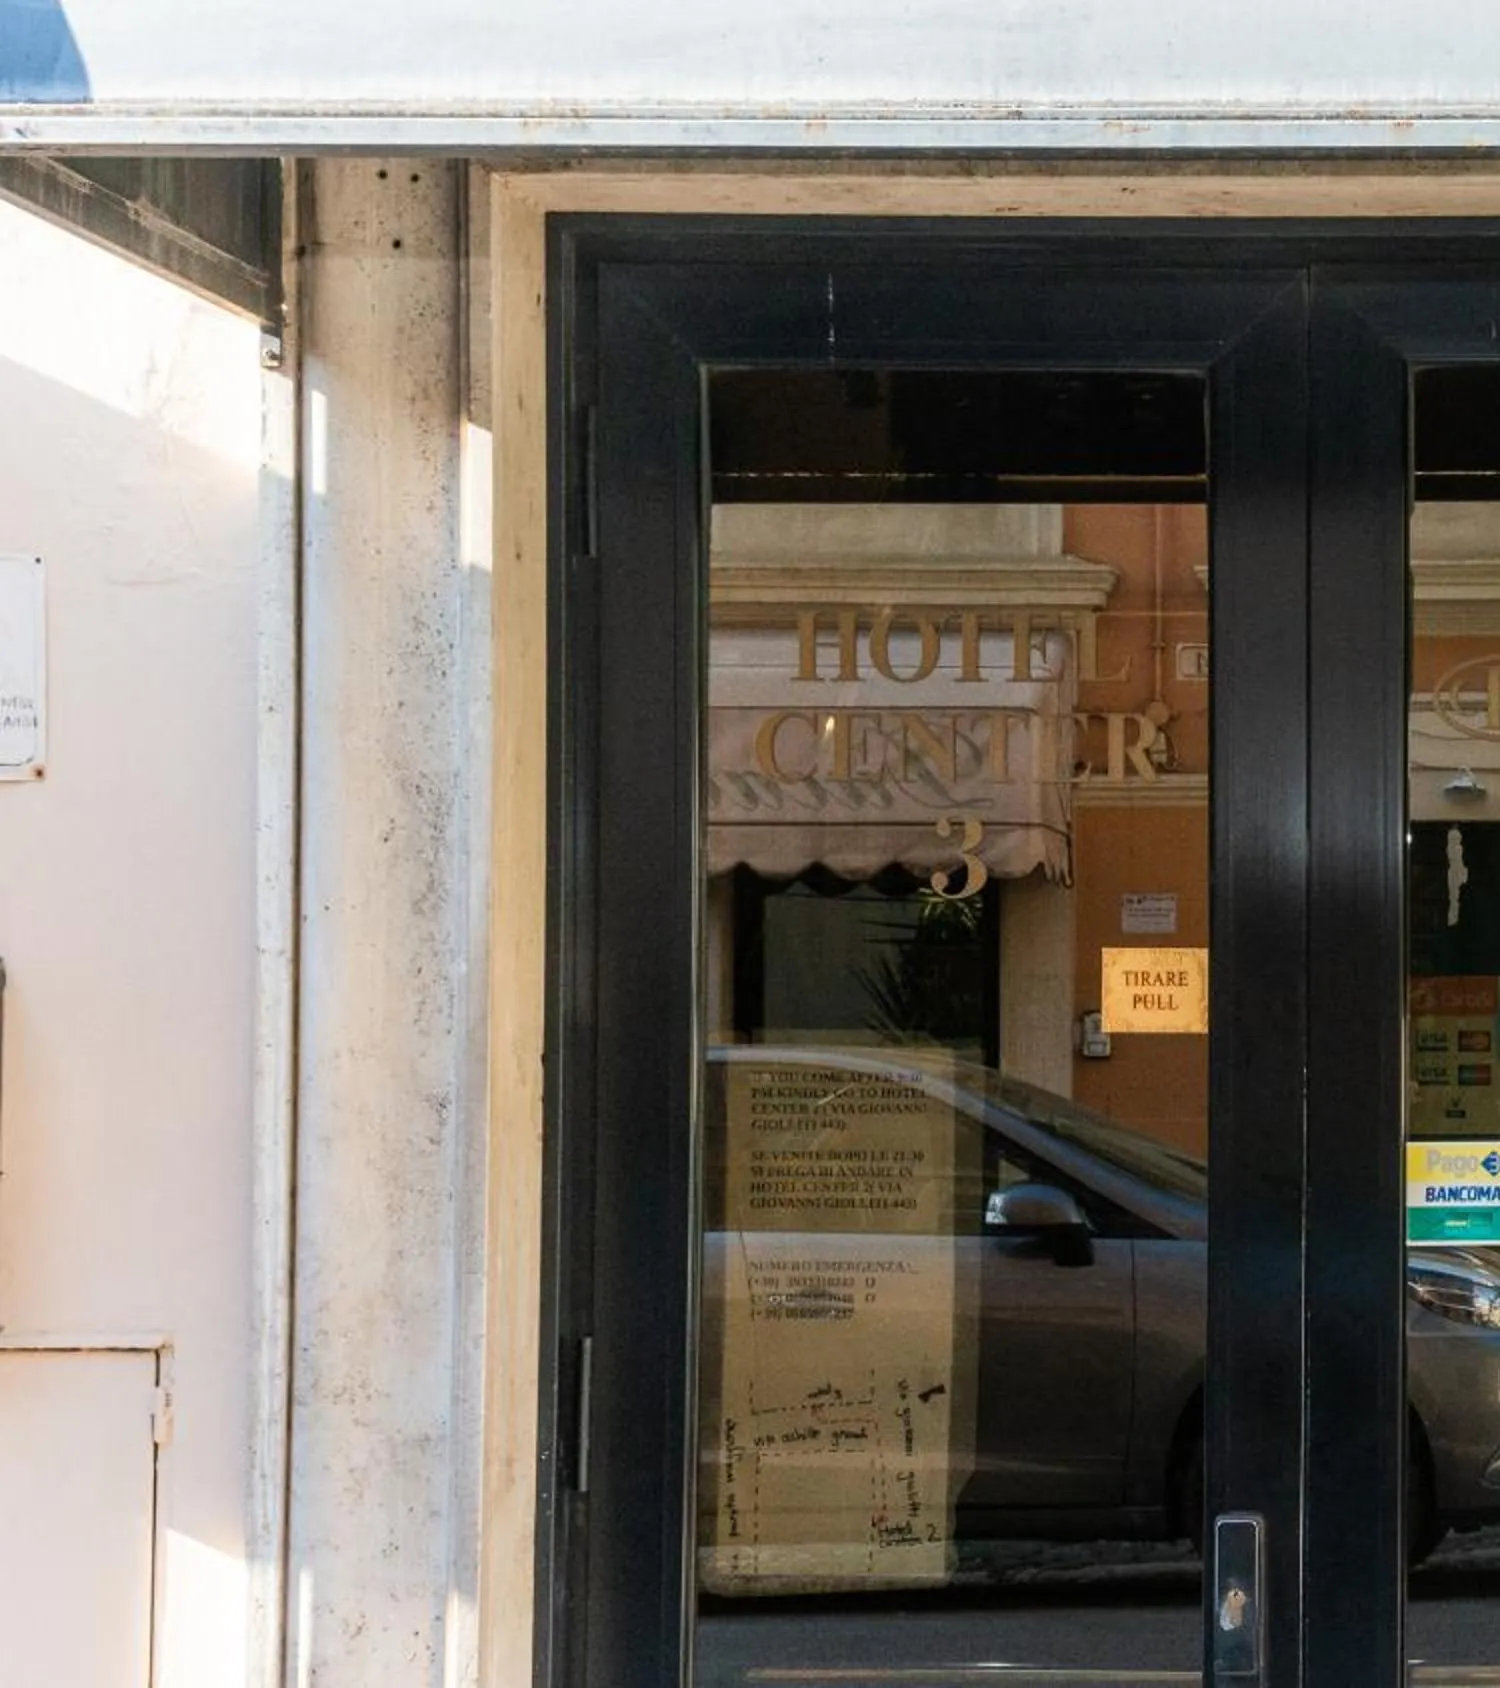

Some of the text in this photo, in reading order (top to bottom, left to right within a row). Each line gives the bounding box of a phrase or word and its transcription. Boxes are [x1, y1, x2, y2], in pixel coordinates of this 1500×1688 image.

[790, 609, 1131, 683] HOTEL
[754, 711, 1166, 784] CENTER
[931, 816, 988, 900] 3
[1122, 970, 1190, 987] TIRARE
[1132, 993, 1180, 1011] PULL
[1426, 1150, 1479, 1178] Pago
